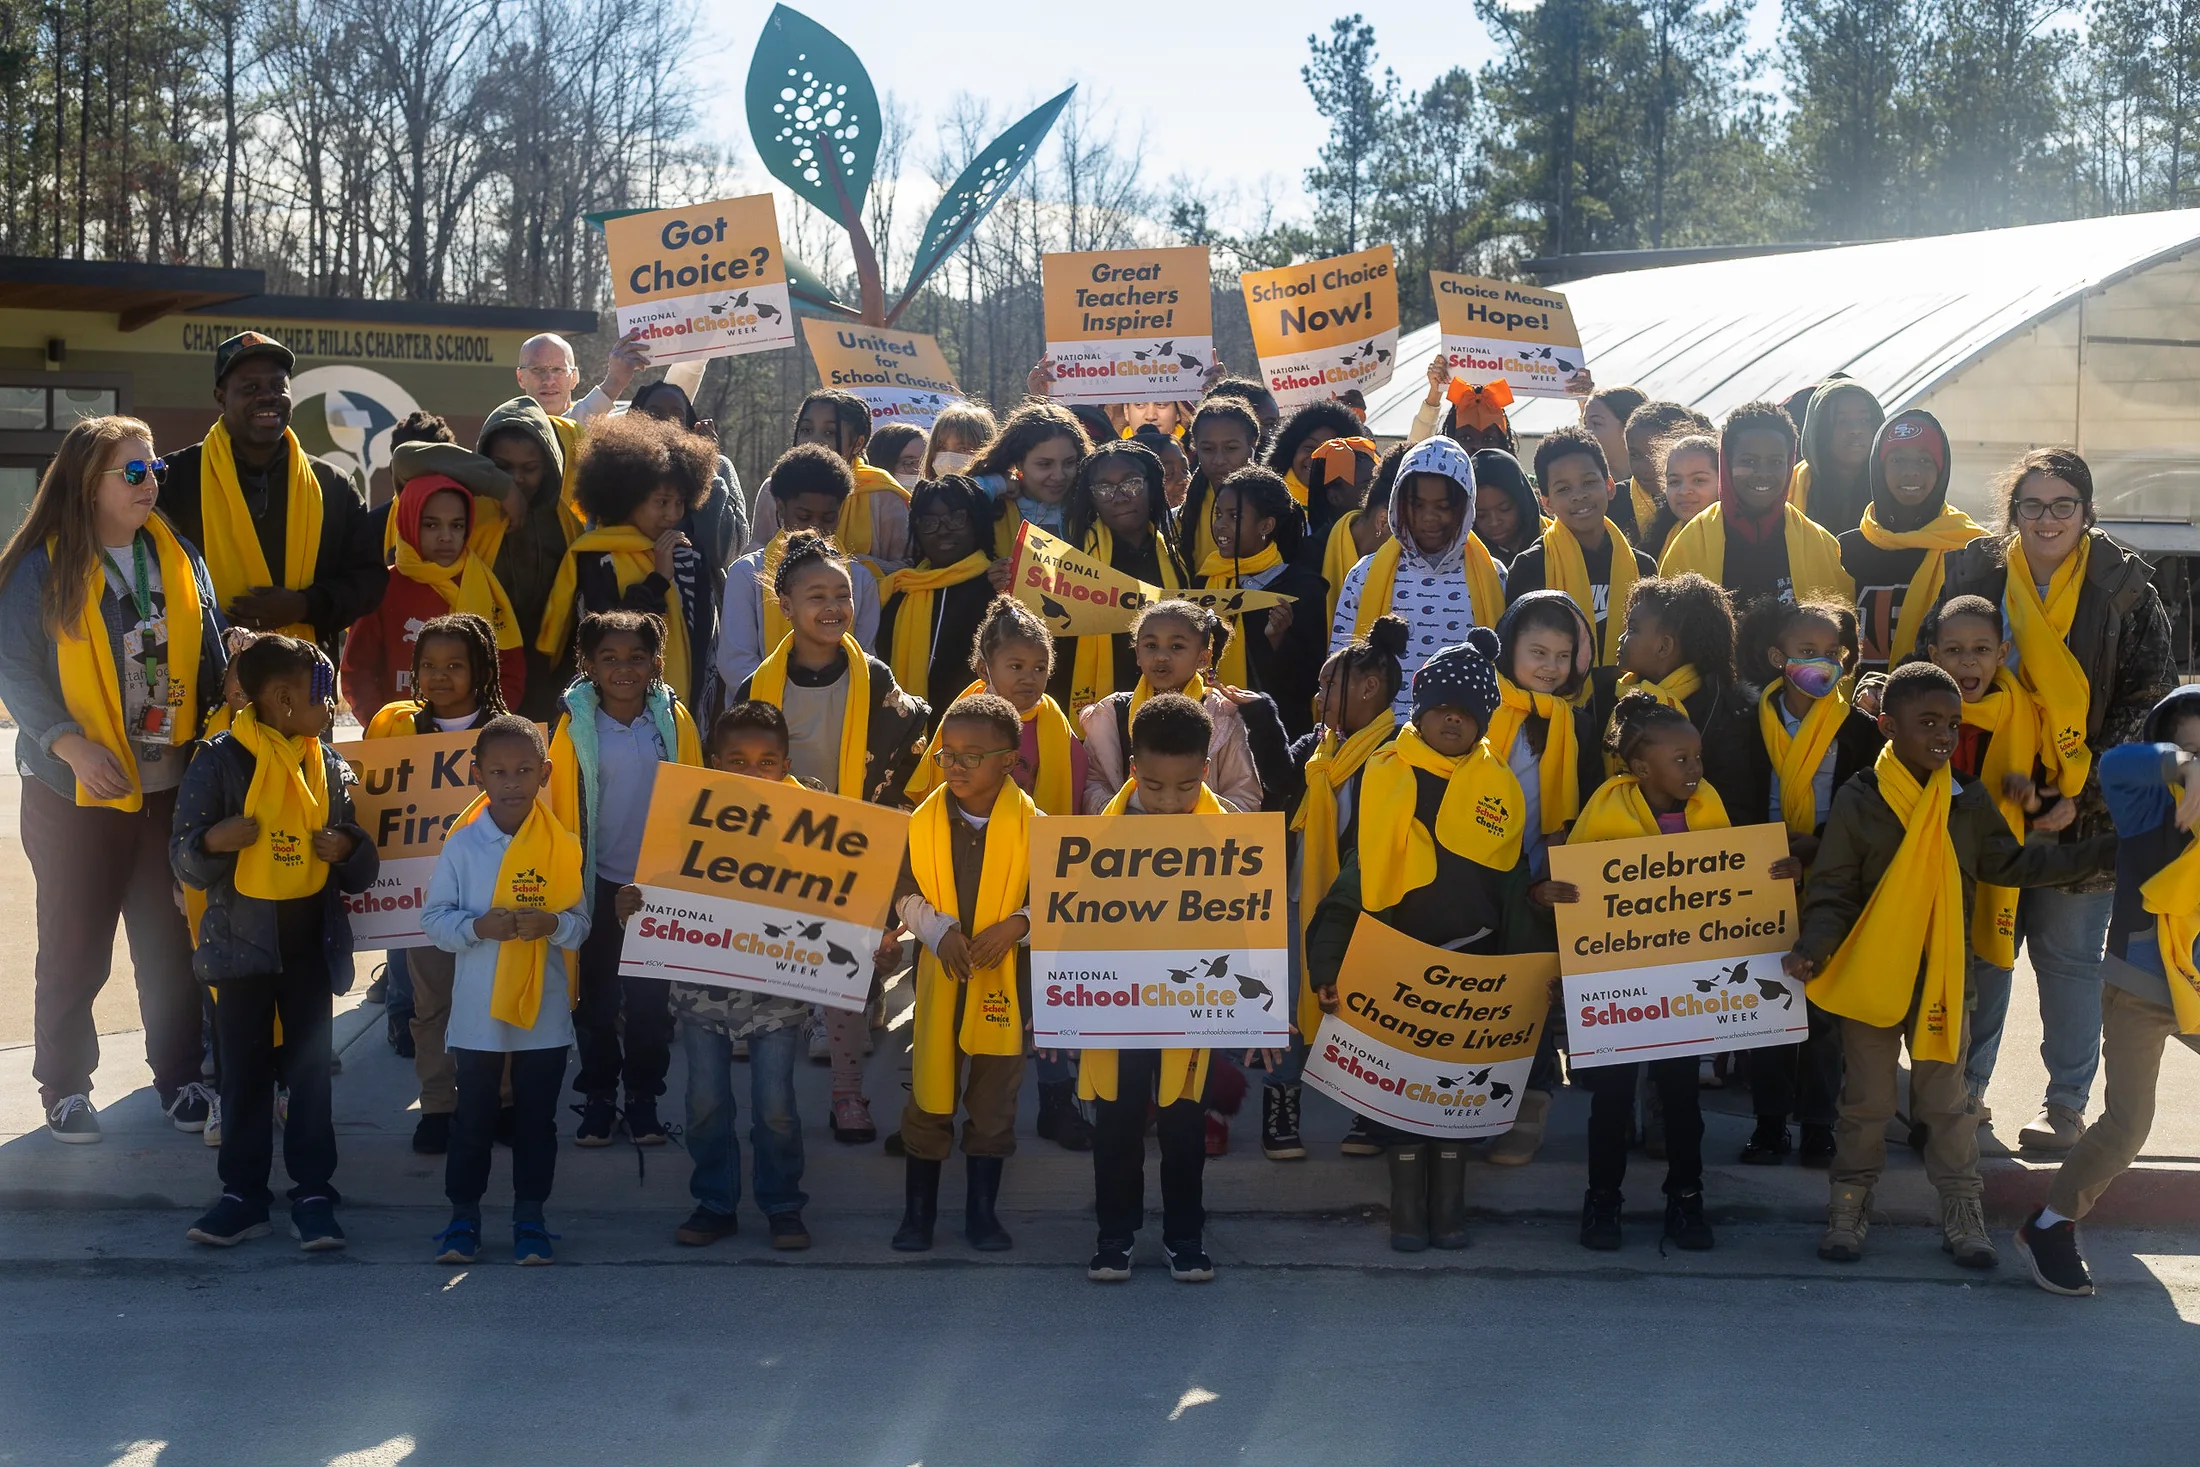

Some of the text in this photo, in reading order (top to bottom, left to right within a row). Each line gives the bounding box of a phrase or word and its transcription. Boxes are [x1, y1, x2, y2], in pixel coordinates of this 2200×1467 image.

[661, 216, 728, 250] Got
[629, 247, 770, 294] Choice?
[1091, 263, 1161, 283] Great
[1252, 263, 1388, 303] School Choice
[1076, 285, 1179, 308] Teachers
[1440, 281, 1563, 310] Choice Means
[629, 311, 677, 325] NATIONAL
[1082, 309, 1173, 335] Inspire!
[1281, 292, 1372, 336] Now!
[1468, 303, 1549, 331] Hope!
[182, 322, 493, 362] CHATTCHEE HILLS CHARTER SCHOOL
[727, 326, 757, 337] WEEK
[837, 331, 918, 357] United
[875, 354, 899, 369] for
[1057, 353, 1101, 361] NATIONAL
[1450, 346, 1491, 355] NATIONAL
[831, 369, 890, 385] School
[1057, 359, 1179, 378] SchoolChoice
[1270, 364, 1310, 375] NATIONAL
[1272, 360, 1378, 391] SchoolChoice
[1449, 354, 1558, 375] SchoolChoice
[1357, 373, 1377, 385] WEEK
[1531, 374, 1557, 382] WEEK
[1032, 551, 1100, 579] NATIONAL
[1025, 566, 1217, 610] SchoolChe
[431, 746, 477, 789] Ki
[377, 804, 462, 847] Firs
[688, 788, 869, 857] Let Me
[1475, 806, 1502, 823] School
[1476, 816, 1504, 833] Choice
[1055, 836, 1264, 878] Parents
[1602, 850, 1746, 884] Celebrate
[679, 840, 858, 907] Learn!
[340, 887, 423, 914] School
[512, 884, 540, 892] School
[516, 894, 545, 902] Choice
[645, 903, 714, 923] NATIONAL
[1046, 888, 1273, 924] Know Best!
[1603, 885, 1732, 918] Teachers
[638, 917, 824, 966] SchoolChoice
[1574, 909, 1786, 956] Celebrate Choice!
[644, 959, 664, 968] #SCW
[775, 961, 819, 978] WEEK
[1048, 971, 1118, 981] NATIONAL
[1423, 965, 1508, 993] Great
[1046, 982, 1237, 1007] SchoolChoice
[1392, 981, 1512, 1022] Teachers
[1581, 987, 1648, 1003] NATIONAL
[983, 1004, 1007, 1013] School
[985, 1014, 1009, 1023] Choice
[1190, 1009, 1235, 1019] WEEK
[1346, 991, 1535, 1050] Change Lives!
[1581, 989, 1759, 1028] SchoolChoice
[1717, 1011, 1759, 1025] WEEK
[1059, 1029, 1078, 1037] #SCW
[1331, 1034, 1391, 1071] NATIONAL
[1596, 1046, 1614, 1055] #SCW
[1323, 1044, 1486, 1107] SchoolChoice
[1444, 1107, 1481, 1117] WEEK
